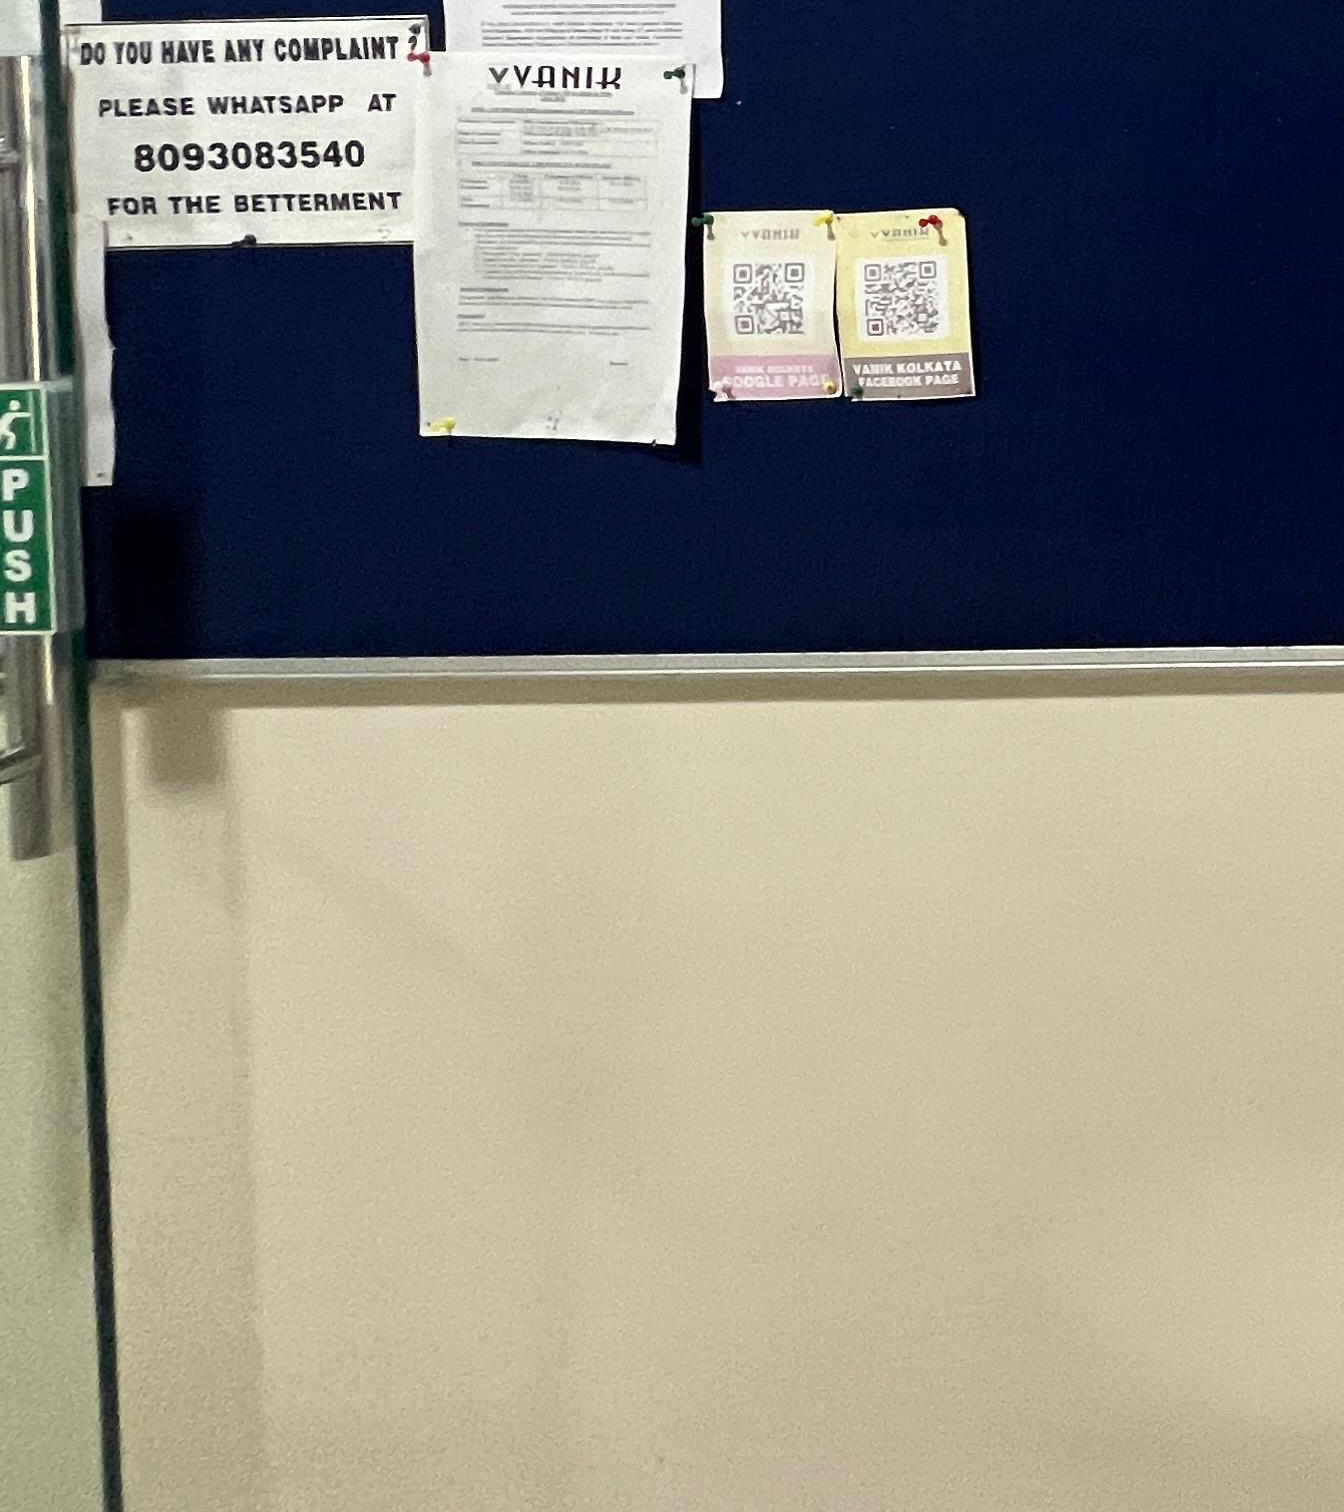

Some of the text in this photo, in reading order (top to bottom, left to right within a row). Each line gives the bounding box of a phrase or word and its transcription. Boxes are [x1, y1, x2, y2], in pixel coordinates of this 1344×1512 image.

[80, 36, 399, 66] DO YOU HAVE ANY COMPLAINT
[514, 66, 622, 90] VANIK
[100, 93, 397, 117] PLEASE WHATSAPP AT
[135, 140, 365, 172] 8093083540
[108, 191, 401, 215] FOR THE BETTERMENT
[896, 361, 961, 374] KOLKATA
[859, 373, 960, 388] FACEBOOK PAGE
[1, 468, 36, 624] PUSH
